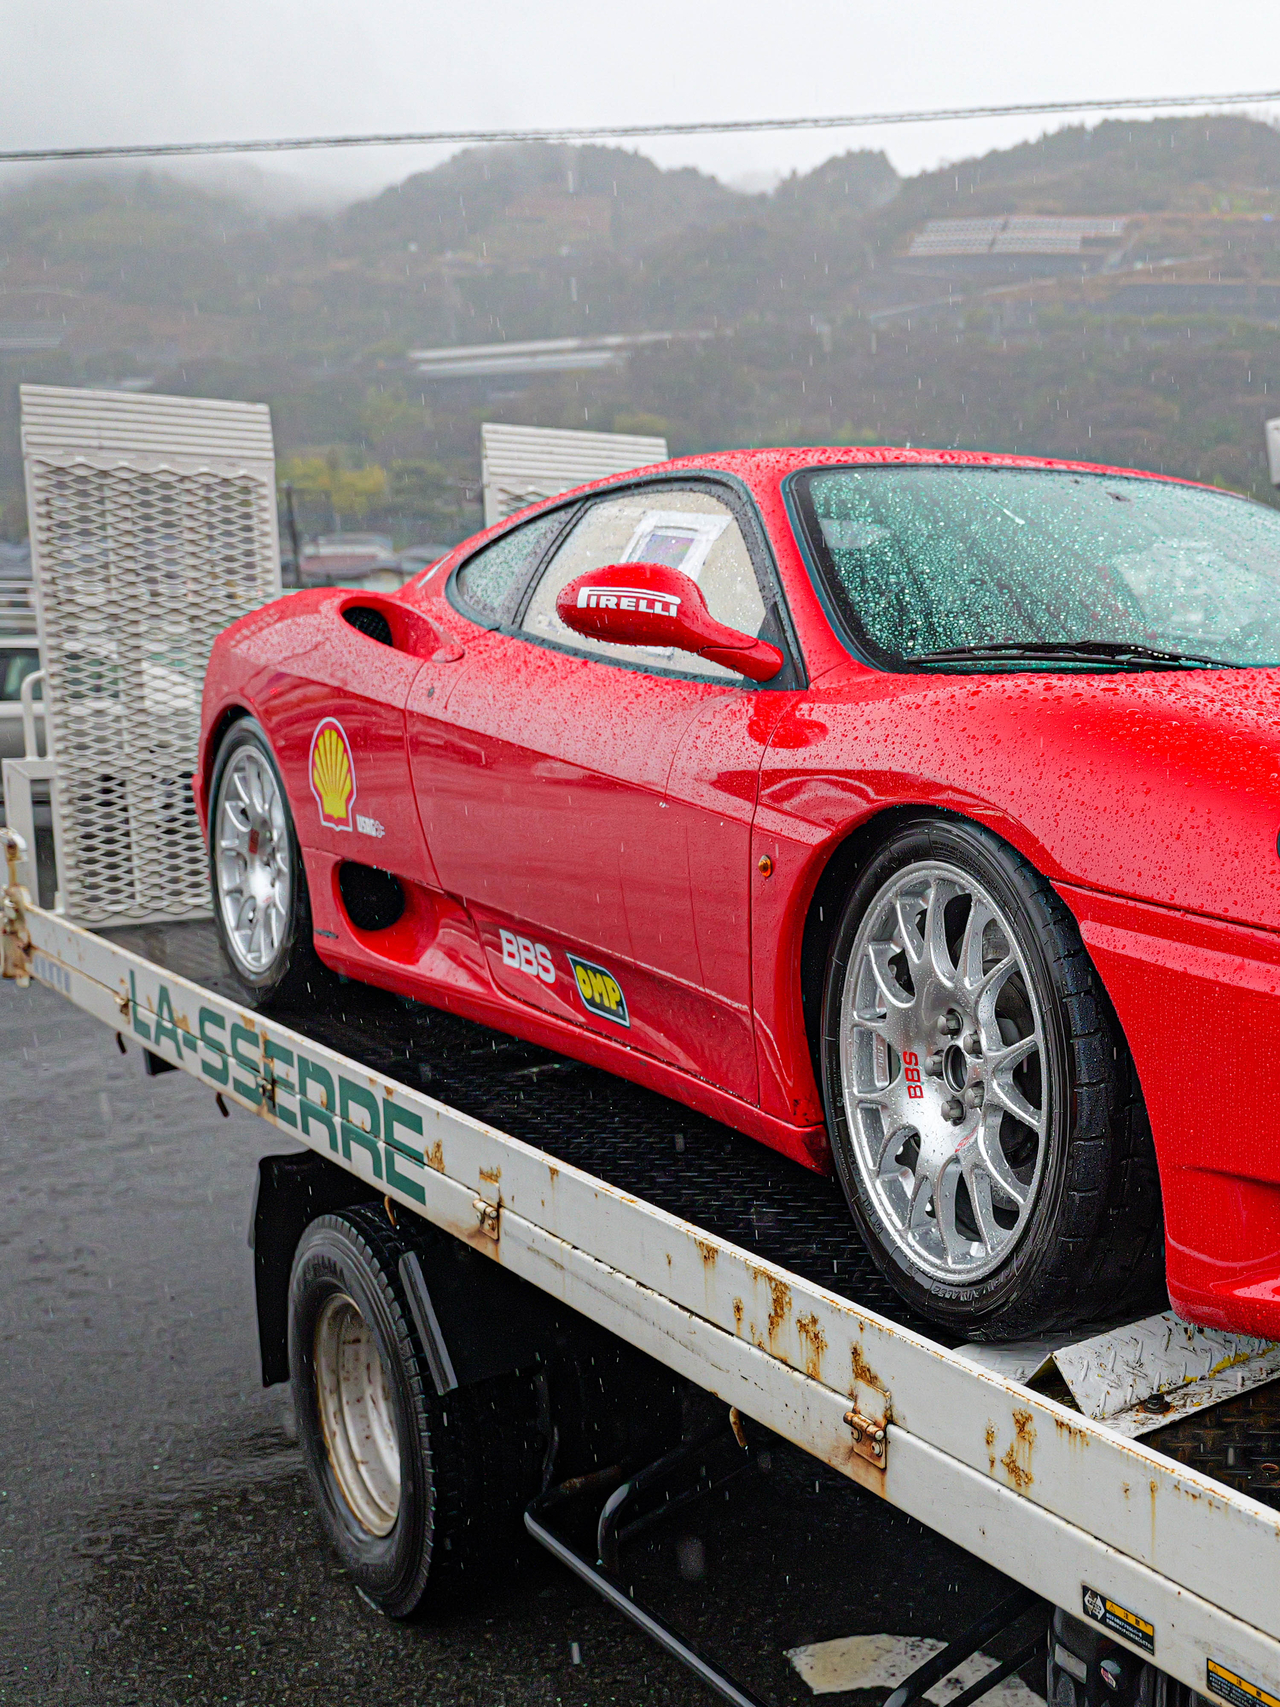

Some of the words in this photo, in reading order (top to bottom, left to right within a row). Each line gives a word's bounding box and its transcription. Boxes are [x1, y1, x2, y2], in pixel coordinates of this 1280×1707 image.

[576, 586, 682, 618] PIRELLI
[498, 928, 556, 984] BBS
[575, 964, 622, 1011] OMP
[129, 969, 427, 1206] LA-SSERRE
[902, 1050, 924, 1099] BBS
